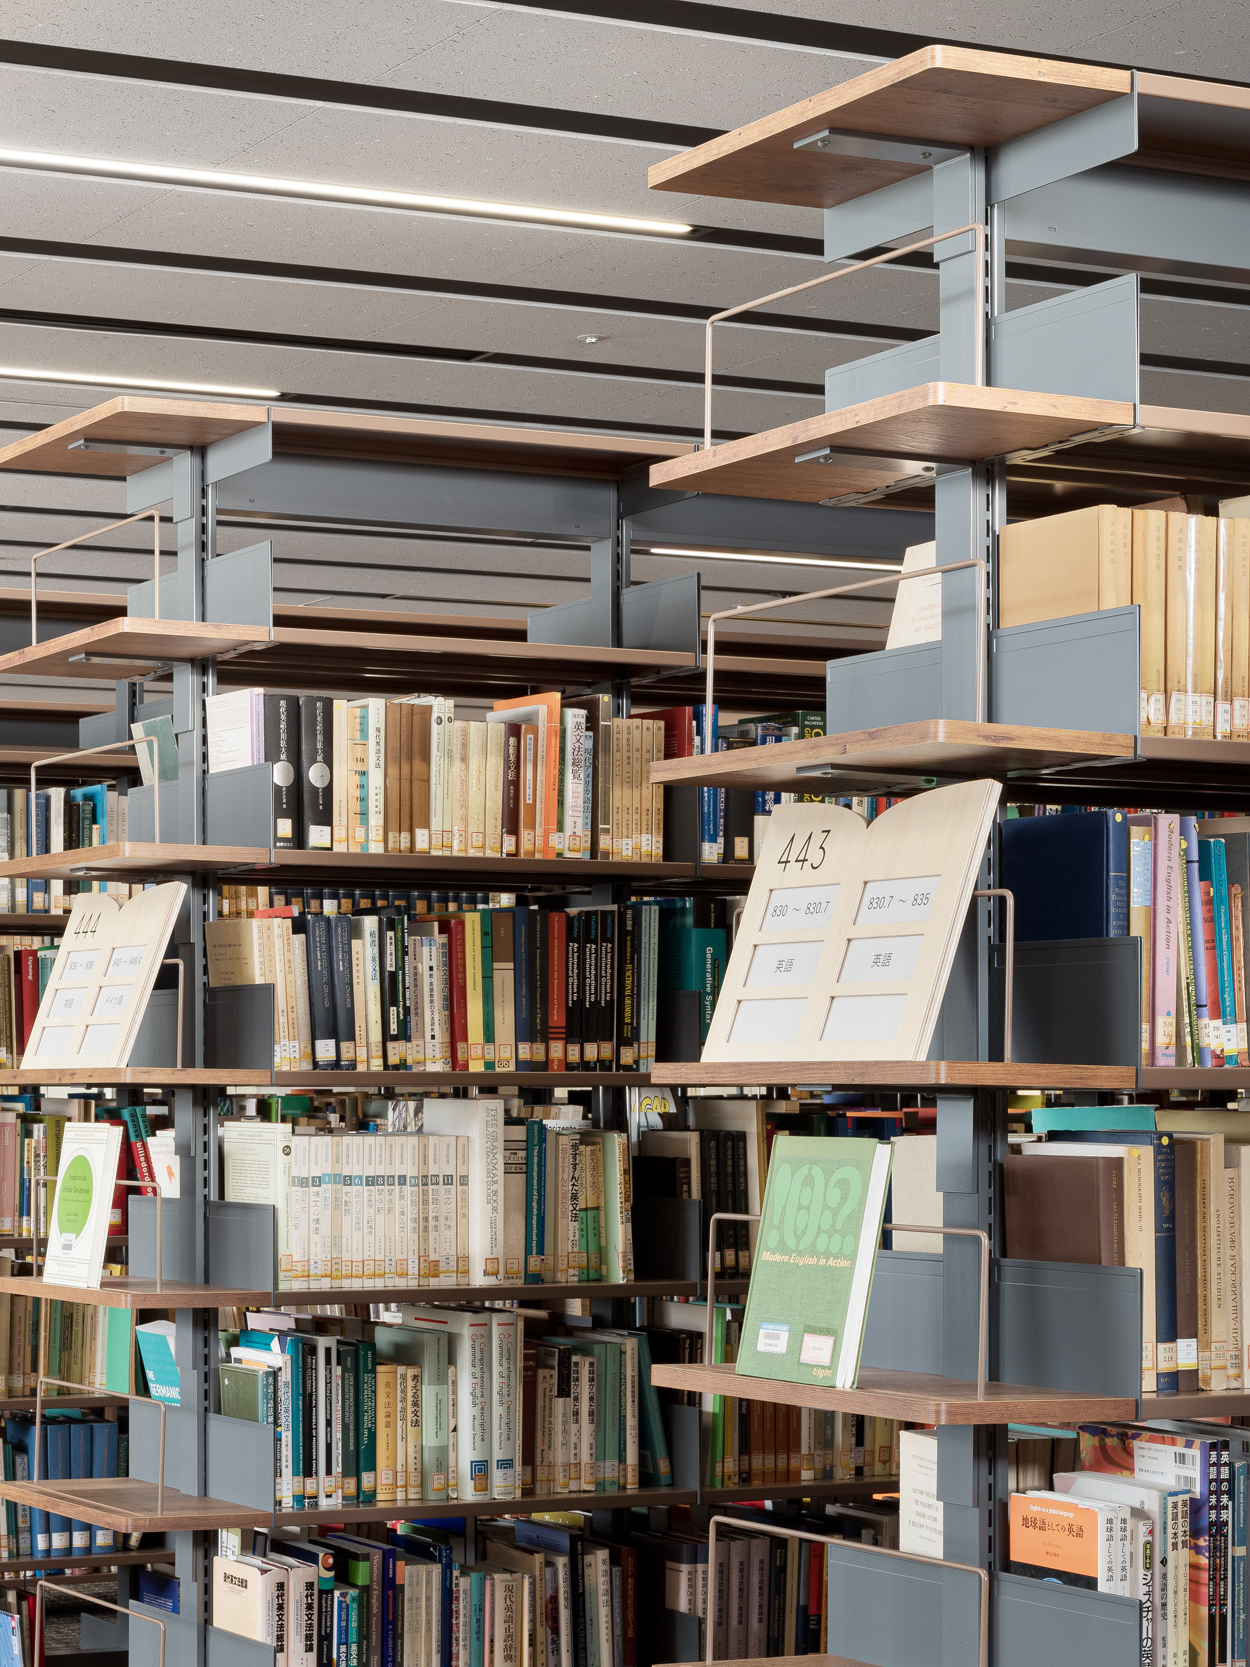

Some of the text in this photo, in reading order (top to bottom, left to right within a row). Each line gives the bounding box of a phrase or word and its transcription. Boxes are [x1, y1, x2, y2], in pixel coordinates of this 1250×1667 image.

[571, 721, 584, 781] 英文法総覧
[777, 829, 831, 872] 443
[1164, 826, 1175, 950] Modern English in Action
[771, 904, 788, 917] 830
[805, 901, 830, 916] 830.7
[867, 895, 894, 910] 830.7
[911, 892, 930, 906] 835
[74, 912, 102, 940] 444
[1185, 921, 1191, 929] AS
[1186, 931, 1192, 940] AN
[573, 942, 578, 952] An
[591, 944, 596, 954] An
[607, 942, 612, 952] An
[773, 958, 794, 974] 英語
[871, 952, 892, 968] 英語
[1188, 945, 1196, 1005] INTERNATIONAL
[573, 992, 578, 1000] to
[591, 993, 596, 1002] to
[607, 992, 612, 1000] to
[705, 995, 713, 1024] Syntax
[1191, 1006, 1199, 1043] LANGUAGE
[490, 1106, 499, 1215] THE GRAMMAR BOOK
[313, 1177, 319, 1185] 3
[409, 1177, 418, 1185] 10
[431, 1176, 439, 1184] 10
[443, 1176, 452, 1184] 11
[460, 1177, 468, 1185] 12
[570, 1138, 580, 1222] 一歩すすんだ英文法
[761, 1250, 852, 1268] Modern English in Action
[472, 1372, 479, 1380] of
[499, 1371, 506, 1379] of
[812, 1366, 833, 1379] Eight
[150, 1383, 181, 1400] GERMANIC
[410, 1373, 421, 1428] 考える英文法
[471, 1382, 479, 1408] English
[497, 1382, 506, 1407] English
[572, 1361, 580, 1425] 意味論から見た語法
[282, 1381, 292, 1433] 現代の英文法
[1209, 1450, 1217, 1522] 英語の未来
[1220, 1450, 1229, 1522] 英語の未来
[1021, 1515, 1084, 1538] 地球語としての英語
[1181, 1499, 1189, 1550] 英語の本質
[1106, 1517, 1114, 1582] 地球語としての英語
[1120, 1517, 1128, 1582] 地球語としての英語
[223, 1572, 248, 1590] 現代英文法総論
[276, 1581, 285, 1654] 現代英文法総論
[304, 1581, 315, 1653] 現代英文法総論
[503, 1583, 515, 1663] 現代英語正誤辞典
